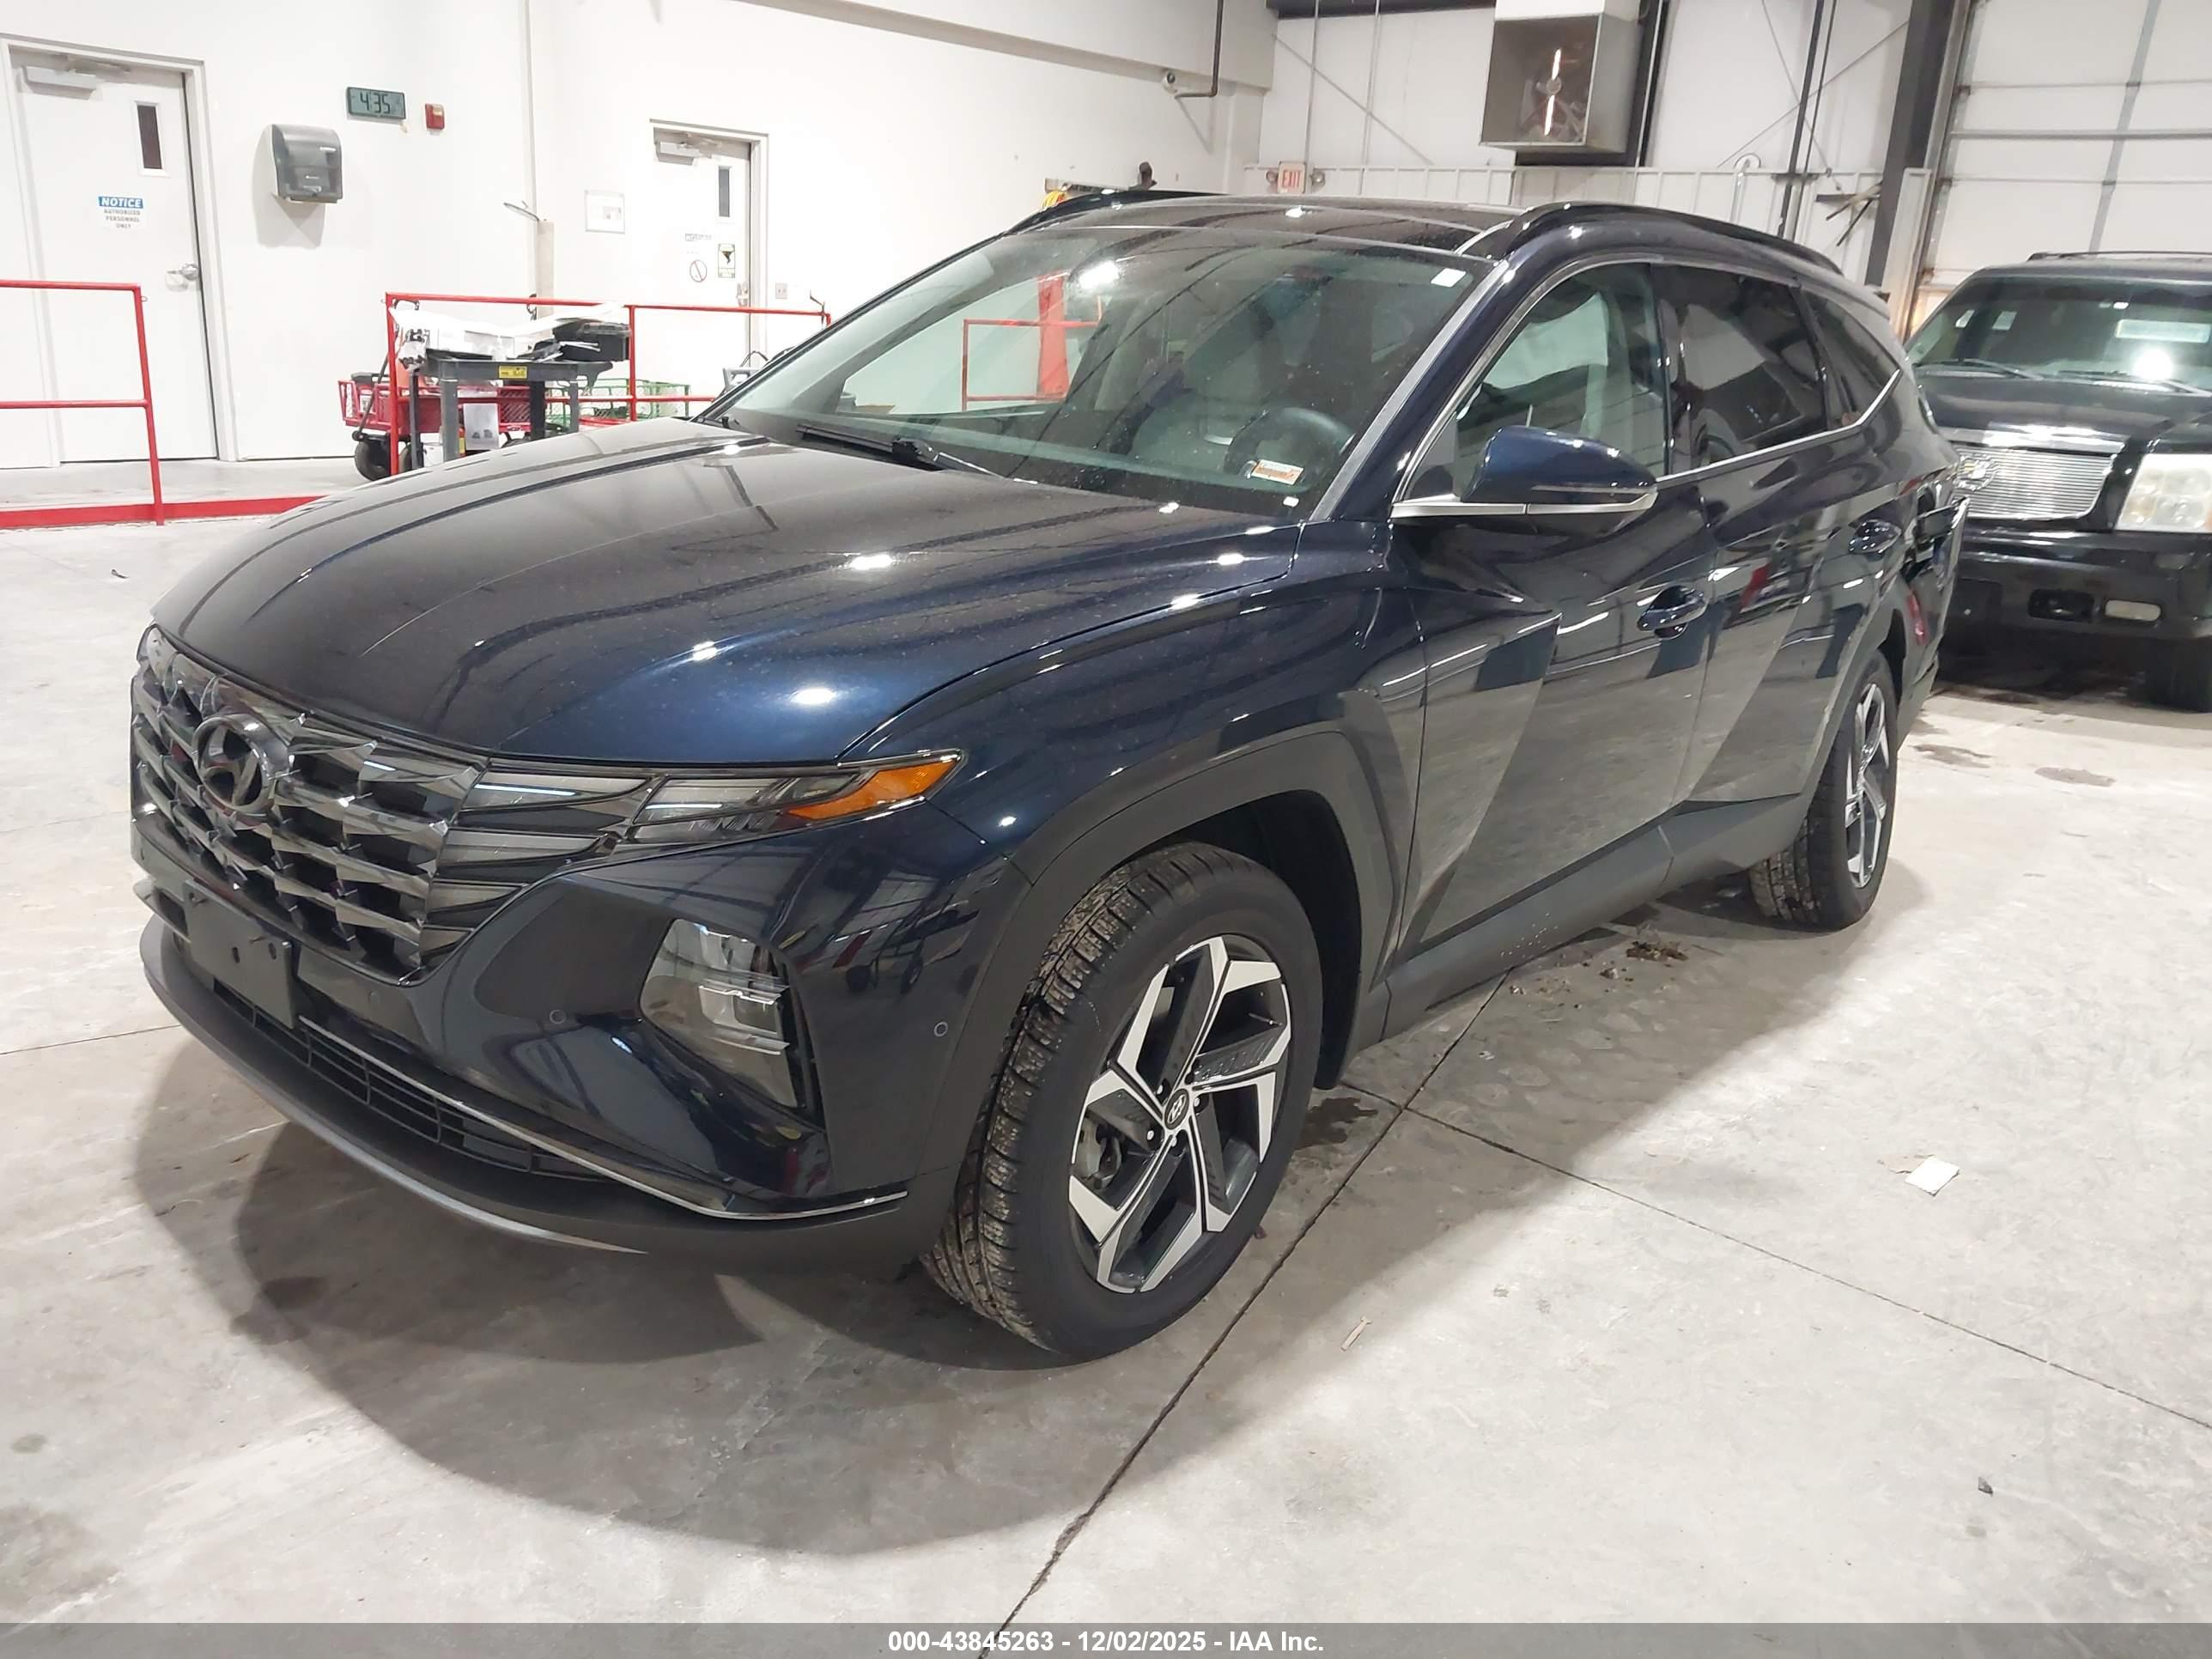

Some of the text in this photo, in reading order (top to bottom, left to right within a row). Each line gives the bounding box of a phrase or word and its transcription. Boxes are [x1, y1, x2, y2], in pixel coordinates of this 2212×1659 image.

[360, 91, 391, 114] 4:35
[1281, 170, 1302, 188] EXIT
[101, 198, 142, 208] NOTICE
